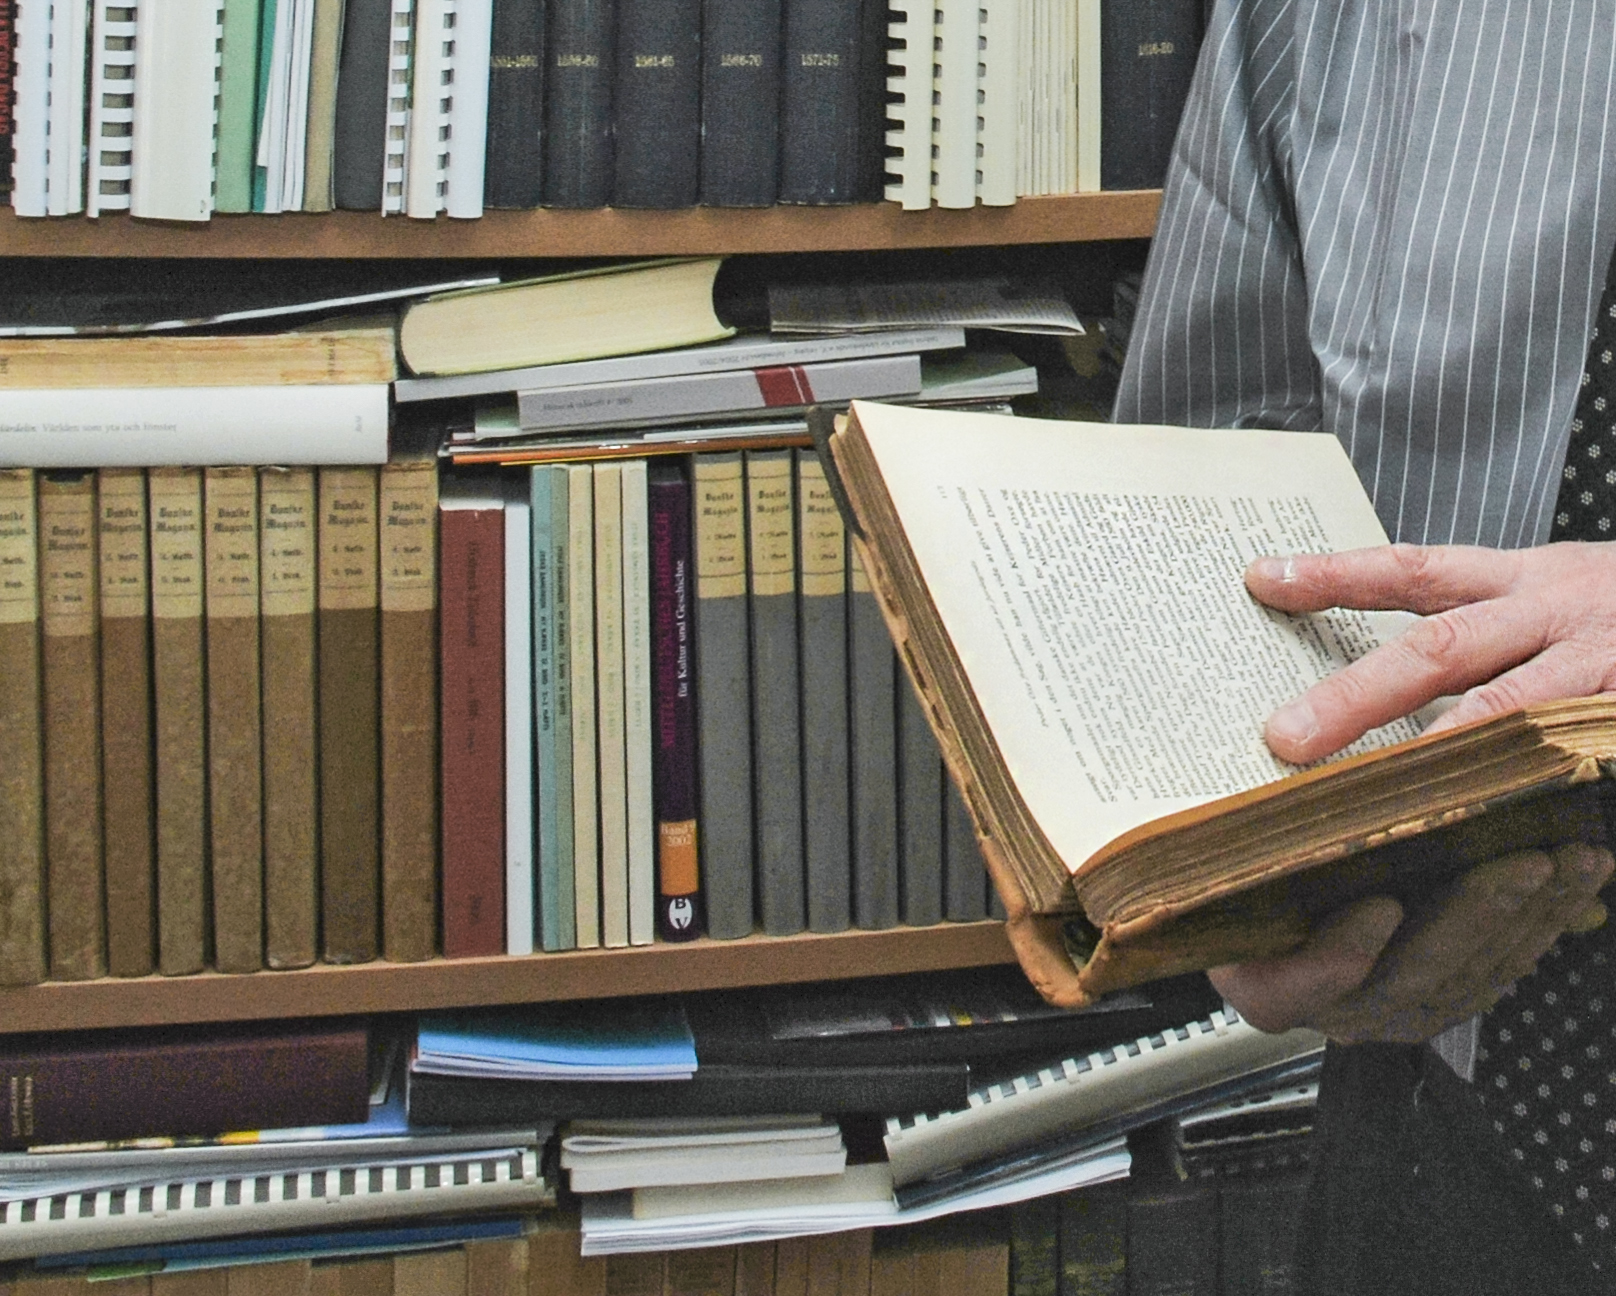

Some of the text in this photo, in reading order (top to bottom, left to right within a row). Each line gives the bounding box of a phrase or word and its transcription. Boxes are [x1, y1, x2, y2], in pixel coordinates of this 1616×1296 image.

[41, 423, 80, 434] Världen
[82, 425, 102, 435] som
[105, 424, 121, 436] yta
[123, 423, 141, 434] och
[675, 560, 688, 698] für Kultur und Geschichte
